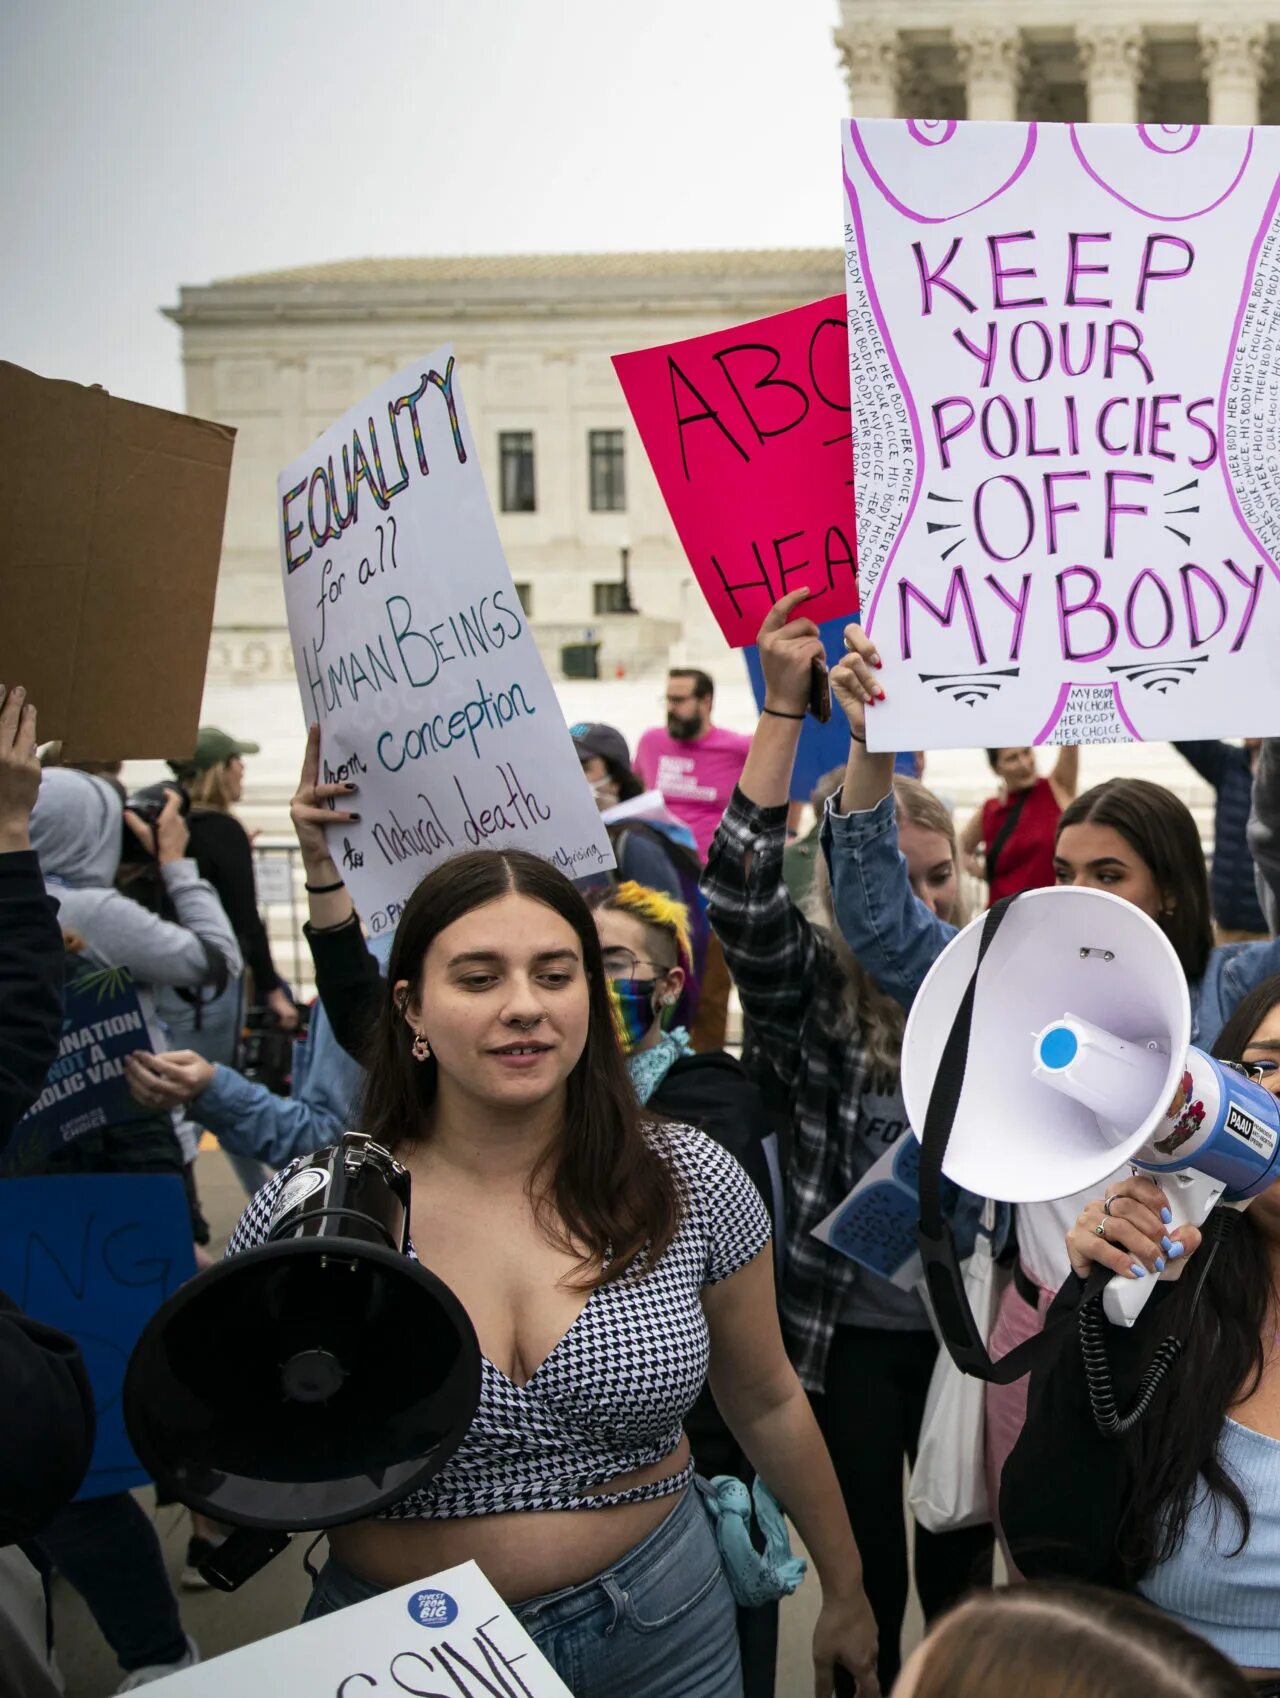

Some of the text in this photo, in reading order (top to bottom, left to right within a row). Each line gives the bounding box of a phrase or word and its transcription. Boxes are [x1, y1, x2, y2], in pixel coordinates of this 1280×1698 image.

[844, 224, 855, 243] MY
[847, 250, 863, 284] BODY
[911, 229, 1196, 316] KEEP
[847, 309, 863, 335] OUR
[872, 384, 889, 410] OUR
[953, 319, 1154, 387] YOUR
[879, 363, 896, 391] HER
[890, 393, 908, 424] BODY
[900, 428, 913, 454] HER
[931, 394, 1219, 470] POLICIES
[282, 356, 468, 574] EQUALITY
[973, 469, 1154, 563] OFF
[317, 516, 398, 652] for all
[899, 558, 1264, 665] MY BODY
[461, 762, 551, 846] death
[90, 1044, 107, 1064] A
[1230, 1111, 1251, 1135] PAAU
[418, 1593, 444, 1601] DIVEST
[419, 1599, 446, 1608] FROM
[420, 1607, 447, 1618] BIG
